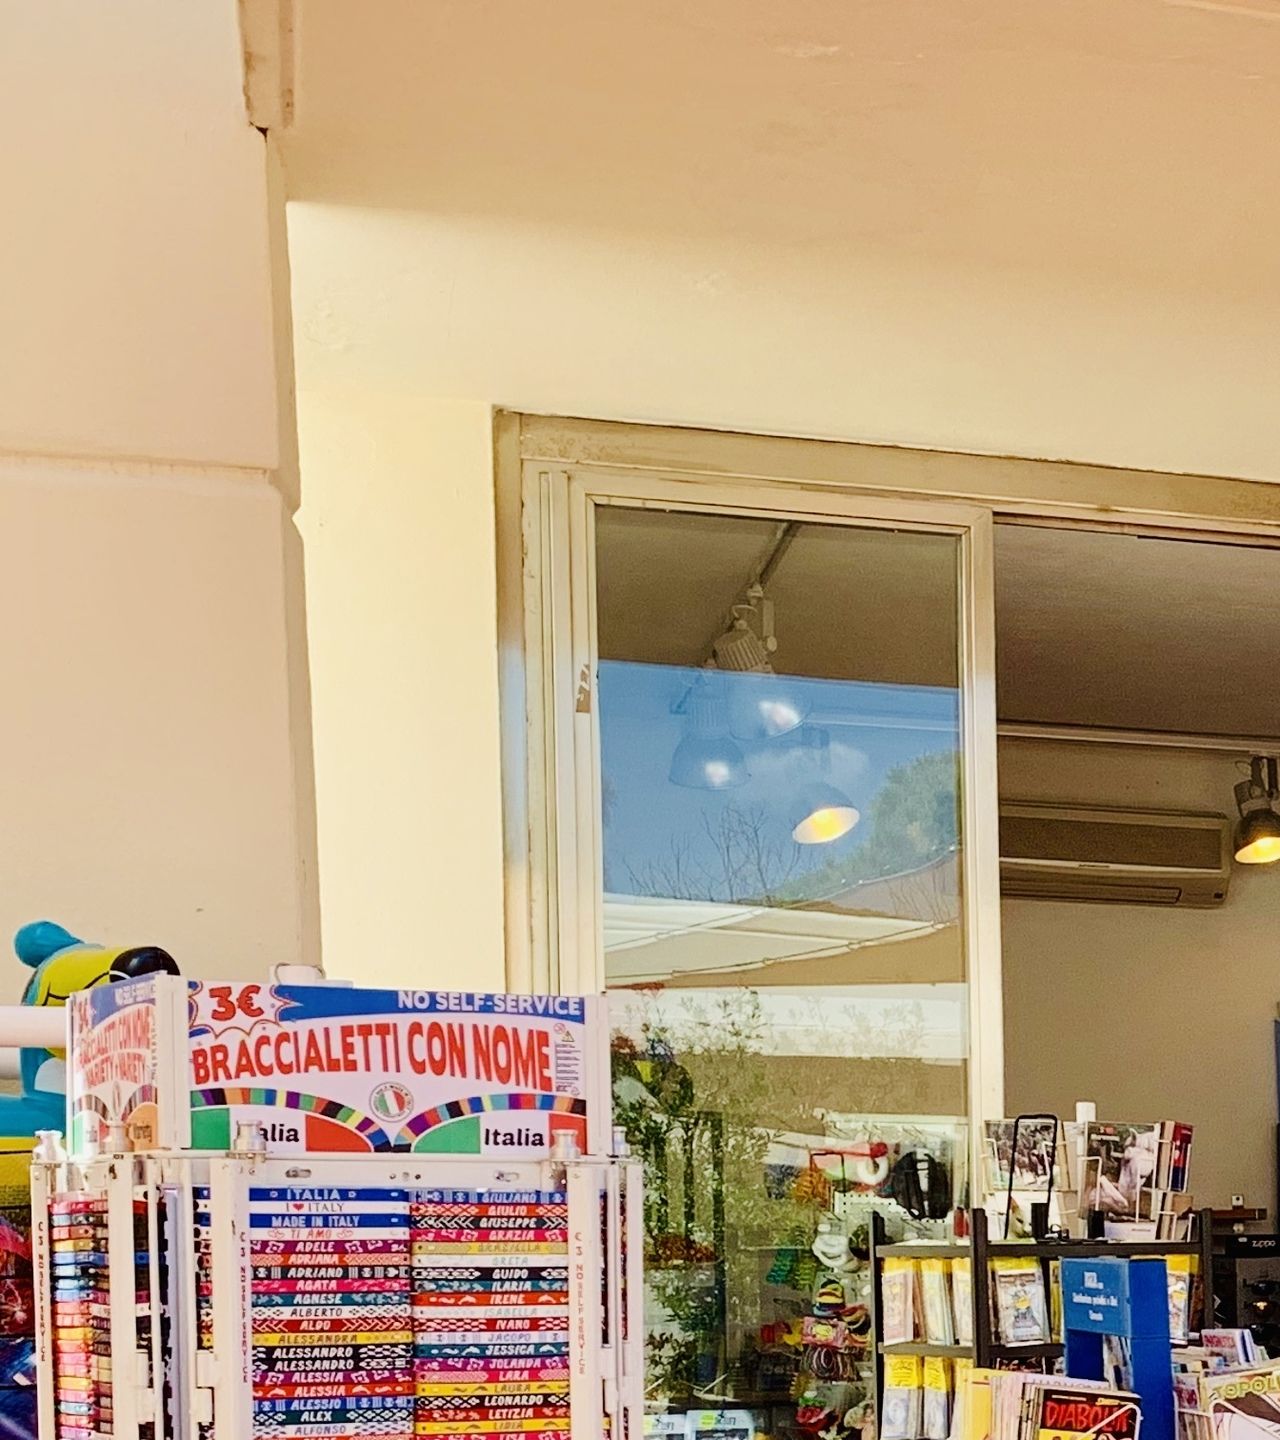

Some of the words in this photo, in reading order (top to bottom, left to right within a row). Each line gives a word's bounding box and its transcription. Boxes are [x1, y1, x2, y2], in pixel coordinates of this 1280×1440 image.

[210, 985, 264, 1022] 3€
[398, 991, 434, 1012] NO
[439, 993, 581, 1016] SELF-SERVICE
[192, 1022, 402, 1086] BRACCIALETTI
[407, 1021, 470, 1078] CON
[475, 1028, 553, 1092] NOME
[484, 1128, 545, 1147] Italia
[287, 1188, 340, 1200] ITALIA
[309, 1202, 344, 1213] ITALY
[488, 1205, 527, 1216] GIULIO
[272, 1215, 305, 1227] MADE
[310, 1215, 322, 1227] IN
[328, 1215, 360, 1227] ITALY
[479, 1217, 537, 1229] GIUSEPPE
[304, 1228, 332, 1239] AMO
[296, 1241, 334, 1253] ADELE
[288, 1267, 342, 1279] ADRIANO
[492, 1268, 529, 1279] GUIDO
[490, 1294, 525, 1304] IRENE
[290, 1307, 342, 1318] ALBERTO
[300, 1319, 329, 1330] ALDO
[273, 1345, 353, 1358] ALESSANDRO
[485, 1344, 534, 1355] JESSICA
[275, 1359, 353, 1371] ALESSANDRO
[485, 1394, 543, 1406] LEONARDO
[300, 1410, 332, 1422] ALEX
